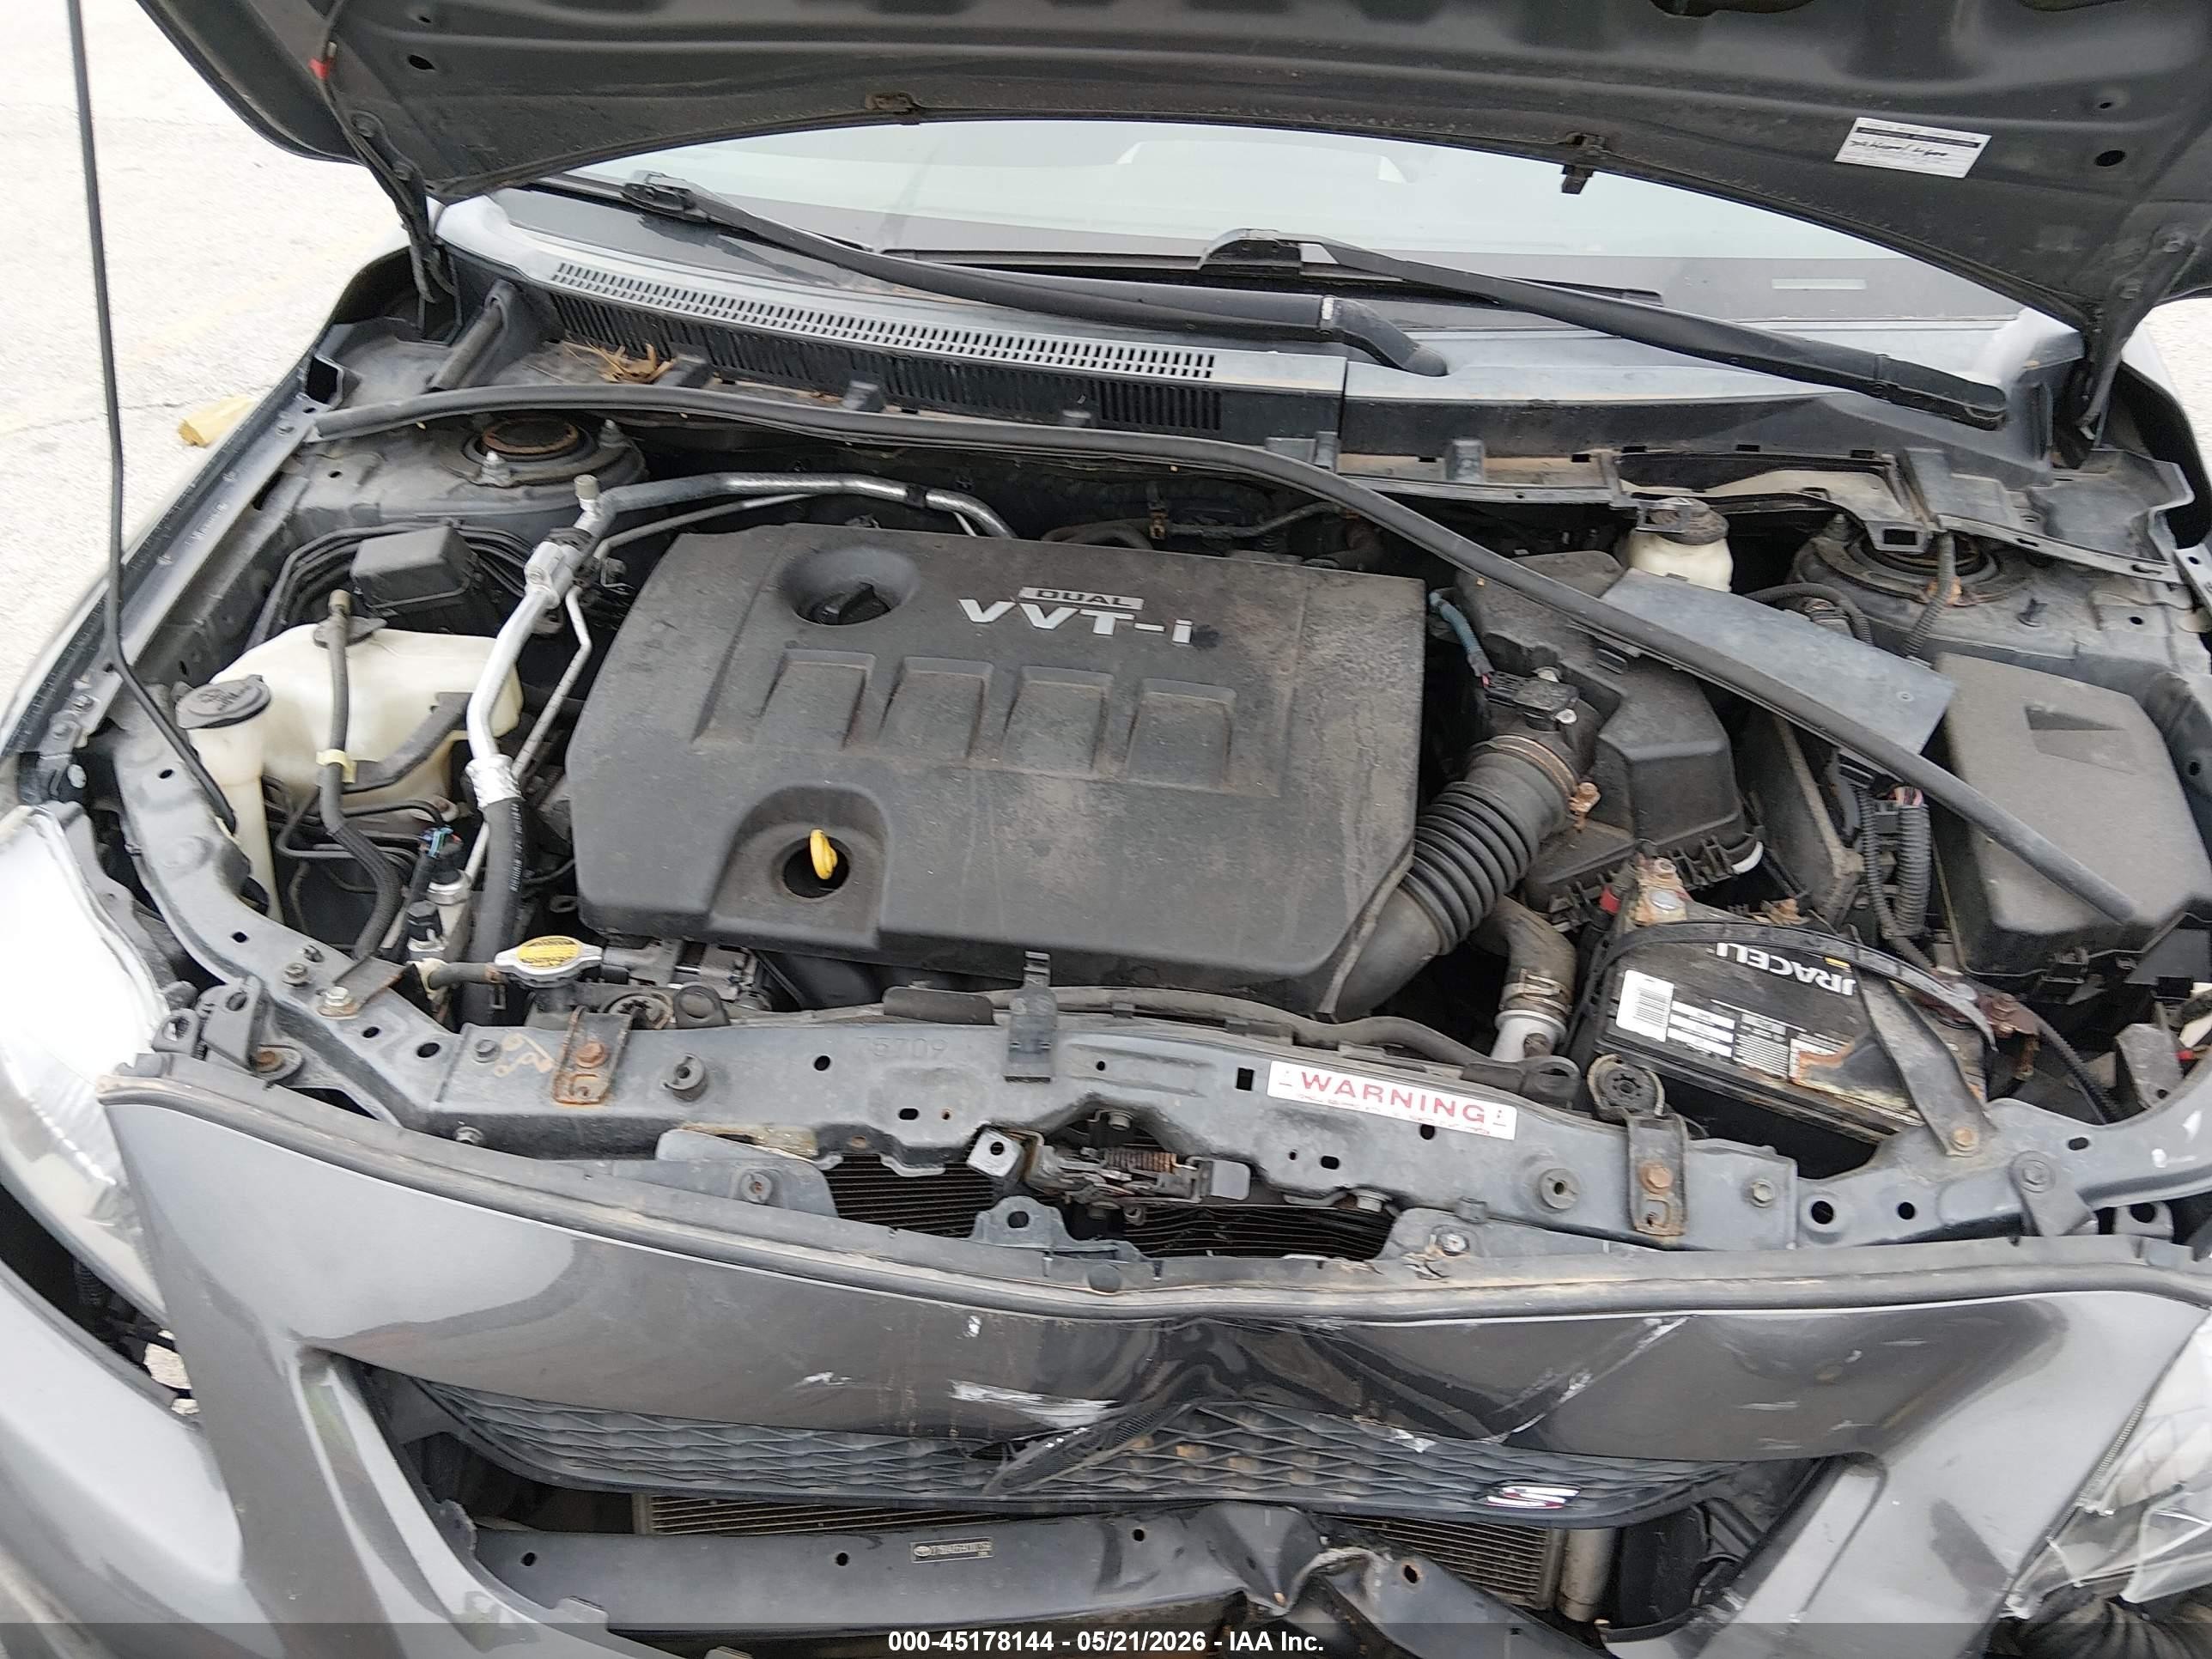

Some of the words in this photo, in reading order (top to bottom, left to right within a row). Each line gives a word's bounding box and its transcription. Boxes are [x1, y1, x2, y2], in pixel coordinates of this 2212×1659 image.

[1035, 589, 1133, 607] DUAL
[957, 599, 1194, 644] VVT-i
[1300, 1071, 1486, 1124] WARNING
